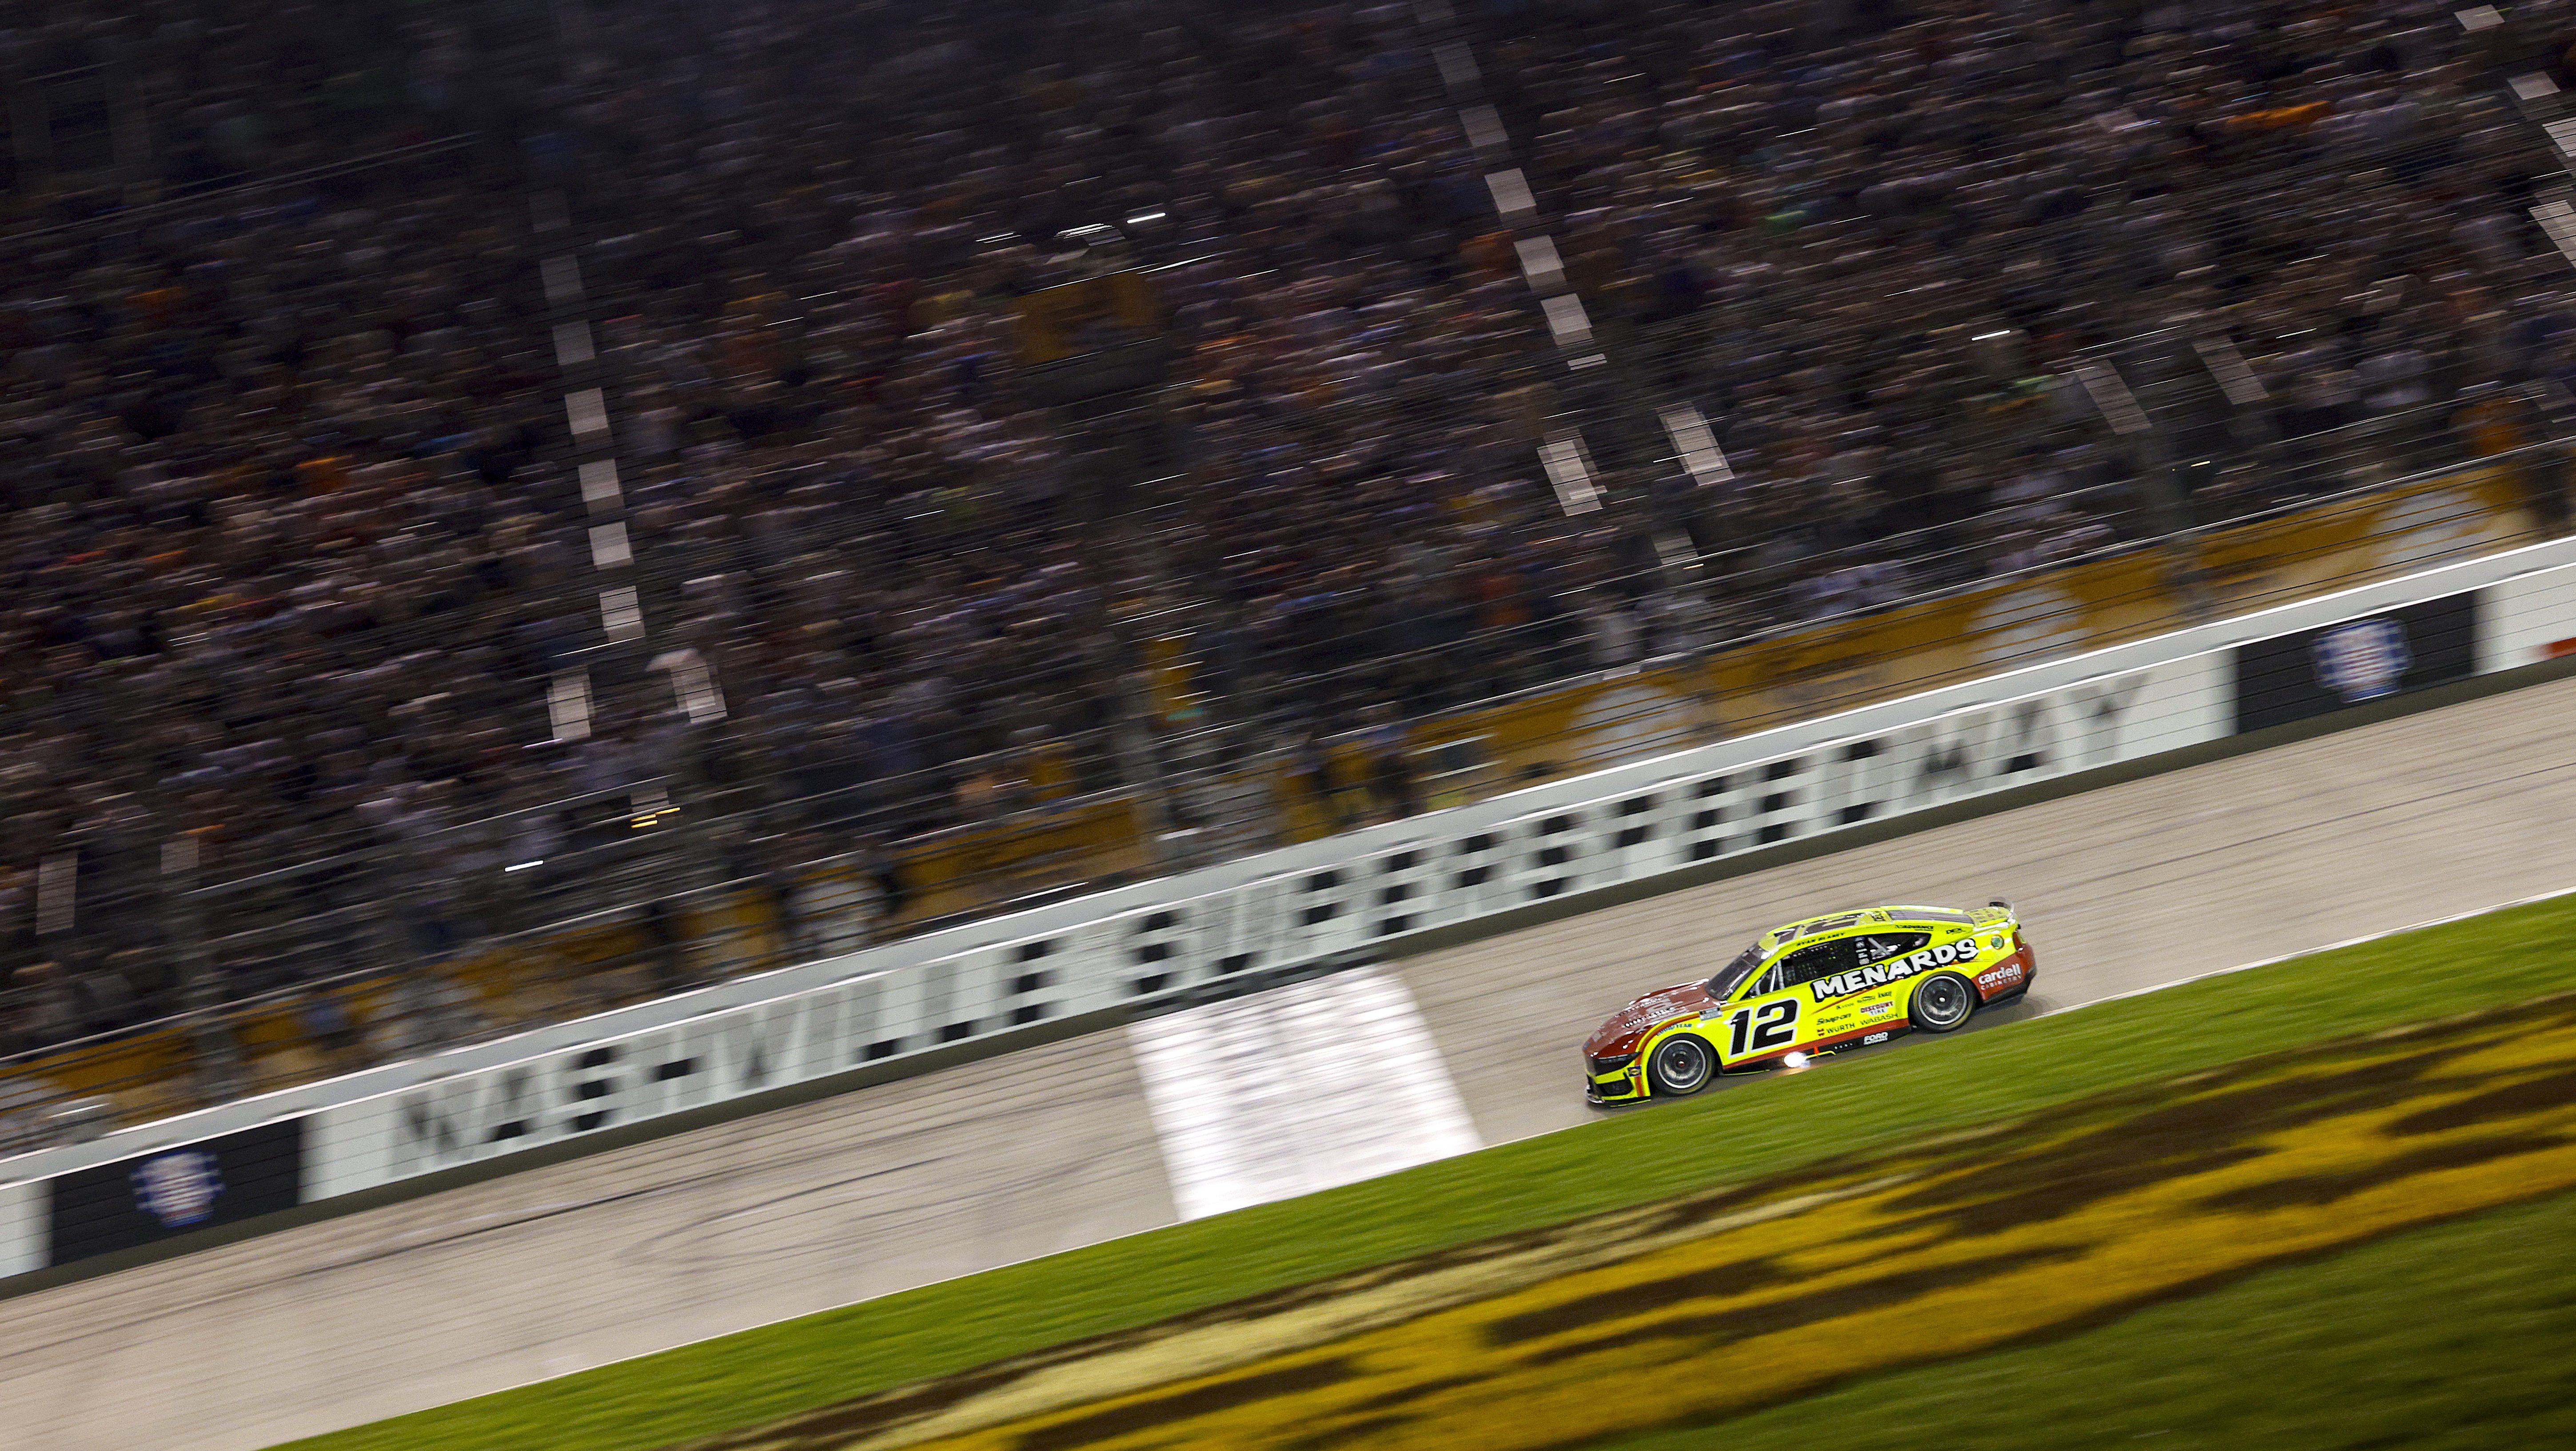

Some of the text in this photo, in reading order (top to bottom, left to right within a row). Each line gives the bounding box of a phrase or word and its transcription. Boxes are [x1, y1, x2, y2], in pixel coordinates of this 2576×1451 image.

[1811, 938, 1979, 1001] MENARDS
[1978, 963, 2021, 985] cardell
[1860, 1001, 1894, 1013] DISCOUNT
[1728, 998, 1800, 1057] 12
[1860, 1013, 1898, 1025] WABASH
[1864, 1032, 1888, 1042] FORD
